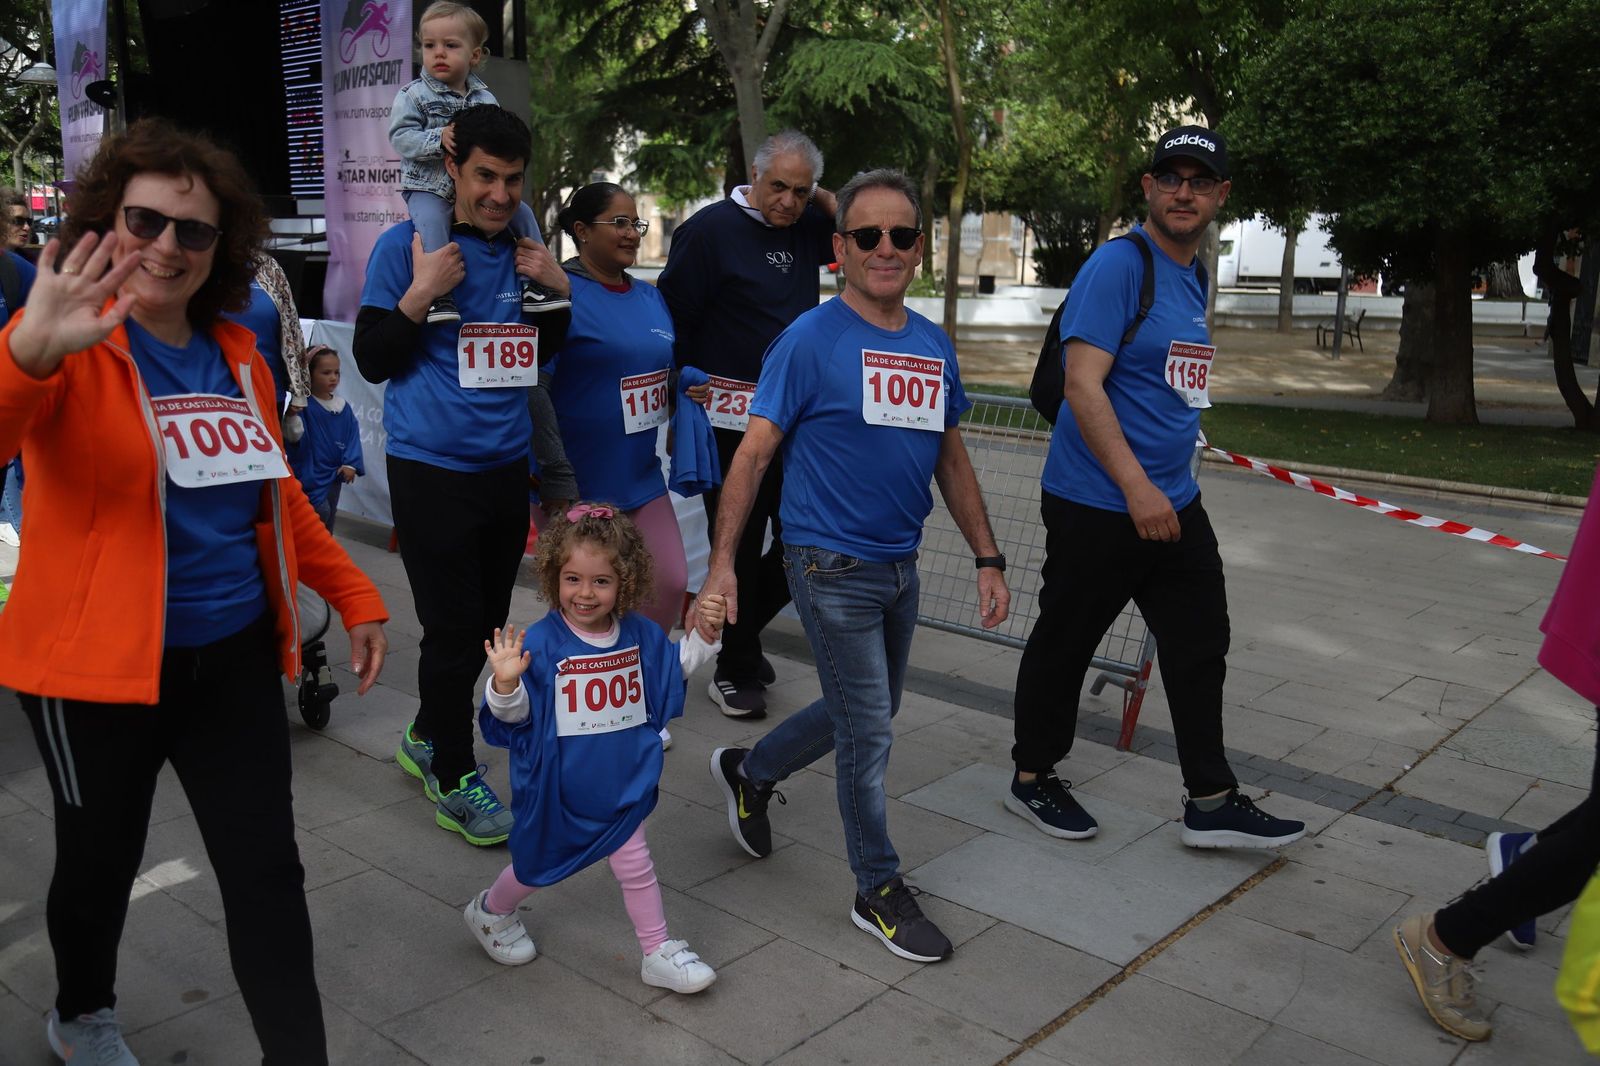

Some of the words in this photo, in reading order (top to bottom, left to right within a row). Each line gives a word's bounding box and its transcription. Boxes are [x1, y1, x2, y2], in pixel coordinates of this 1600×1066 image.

[1164, 134, 1216, 153] adidas
[343, 169, 366, 184] STAR
[368, 169, 402, 183] NIGHT
[463, 341, 535, 369] 1189
[866, 355, 879, 364] DÍA
[880, 357, 889, 365] DE
[889, 359, 918, 369] CASTILLA
[923, 362, 940, 372] LEÓN
[623, 380, 632, 388] DÍA
[722, 382, 746, 390] CASTILLA
[1168, 360, 1208, 391] 1158
[625, 384, 667, 417] 1130
[868, 371, 941, 410] 1007
[155, 402, 168, 412] ÍA
[169, 401, 183, 411] DE
[183, 399, 224, 410] CASTILLA
[705, 391, 752, 416] 123
[162, 416, 273, 460] 1003
[576, 662, 587, 670] DE
[588, 657, 621, 669] CASTILLA
[625, 652, 638, 664] LEÓN
[562, 669, 642, 713] 1005
